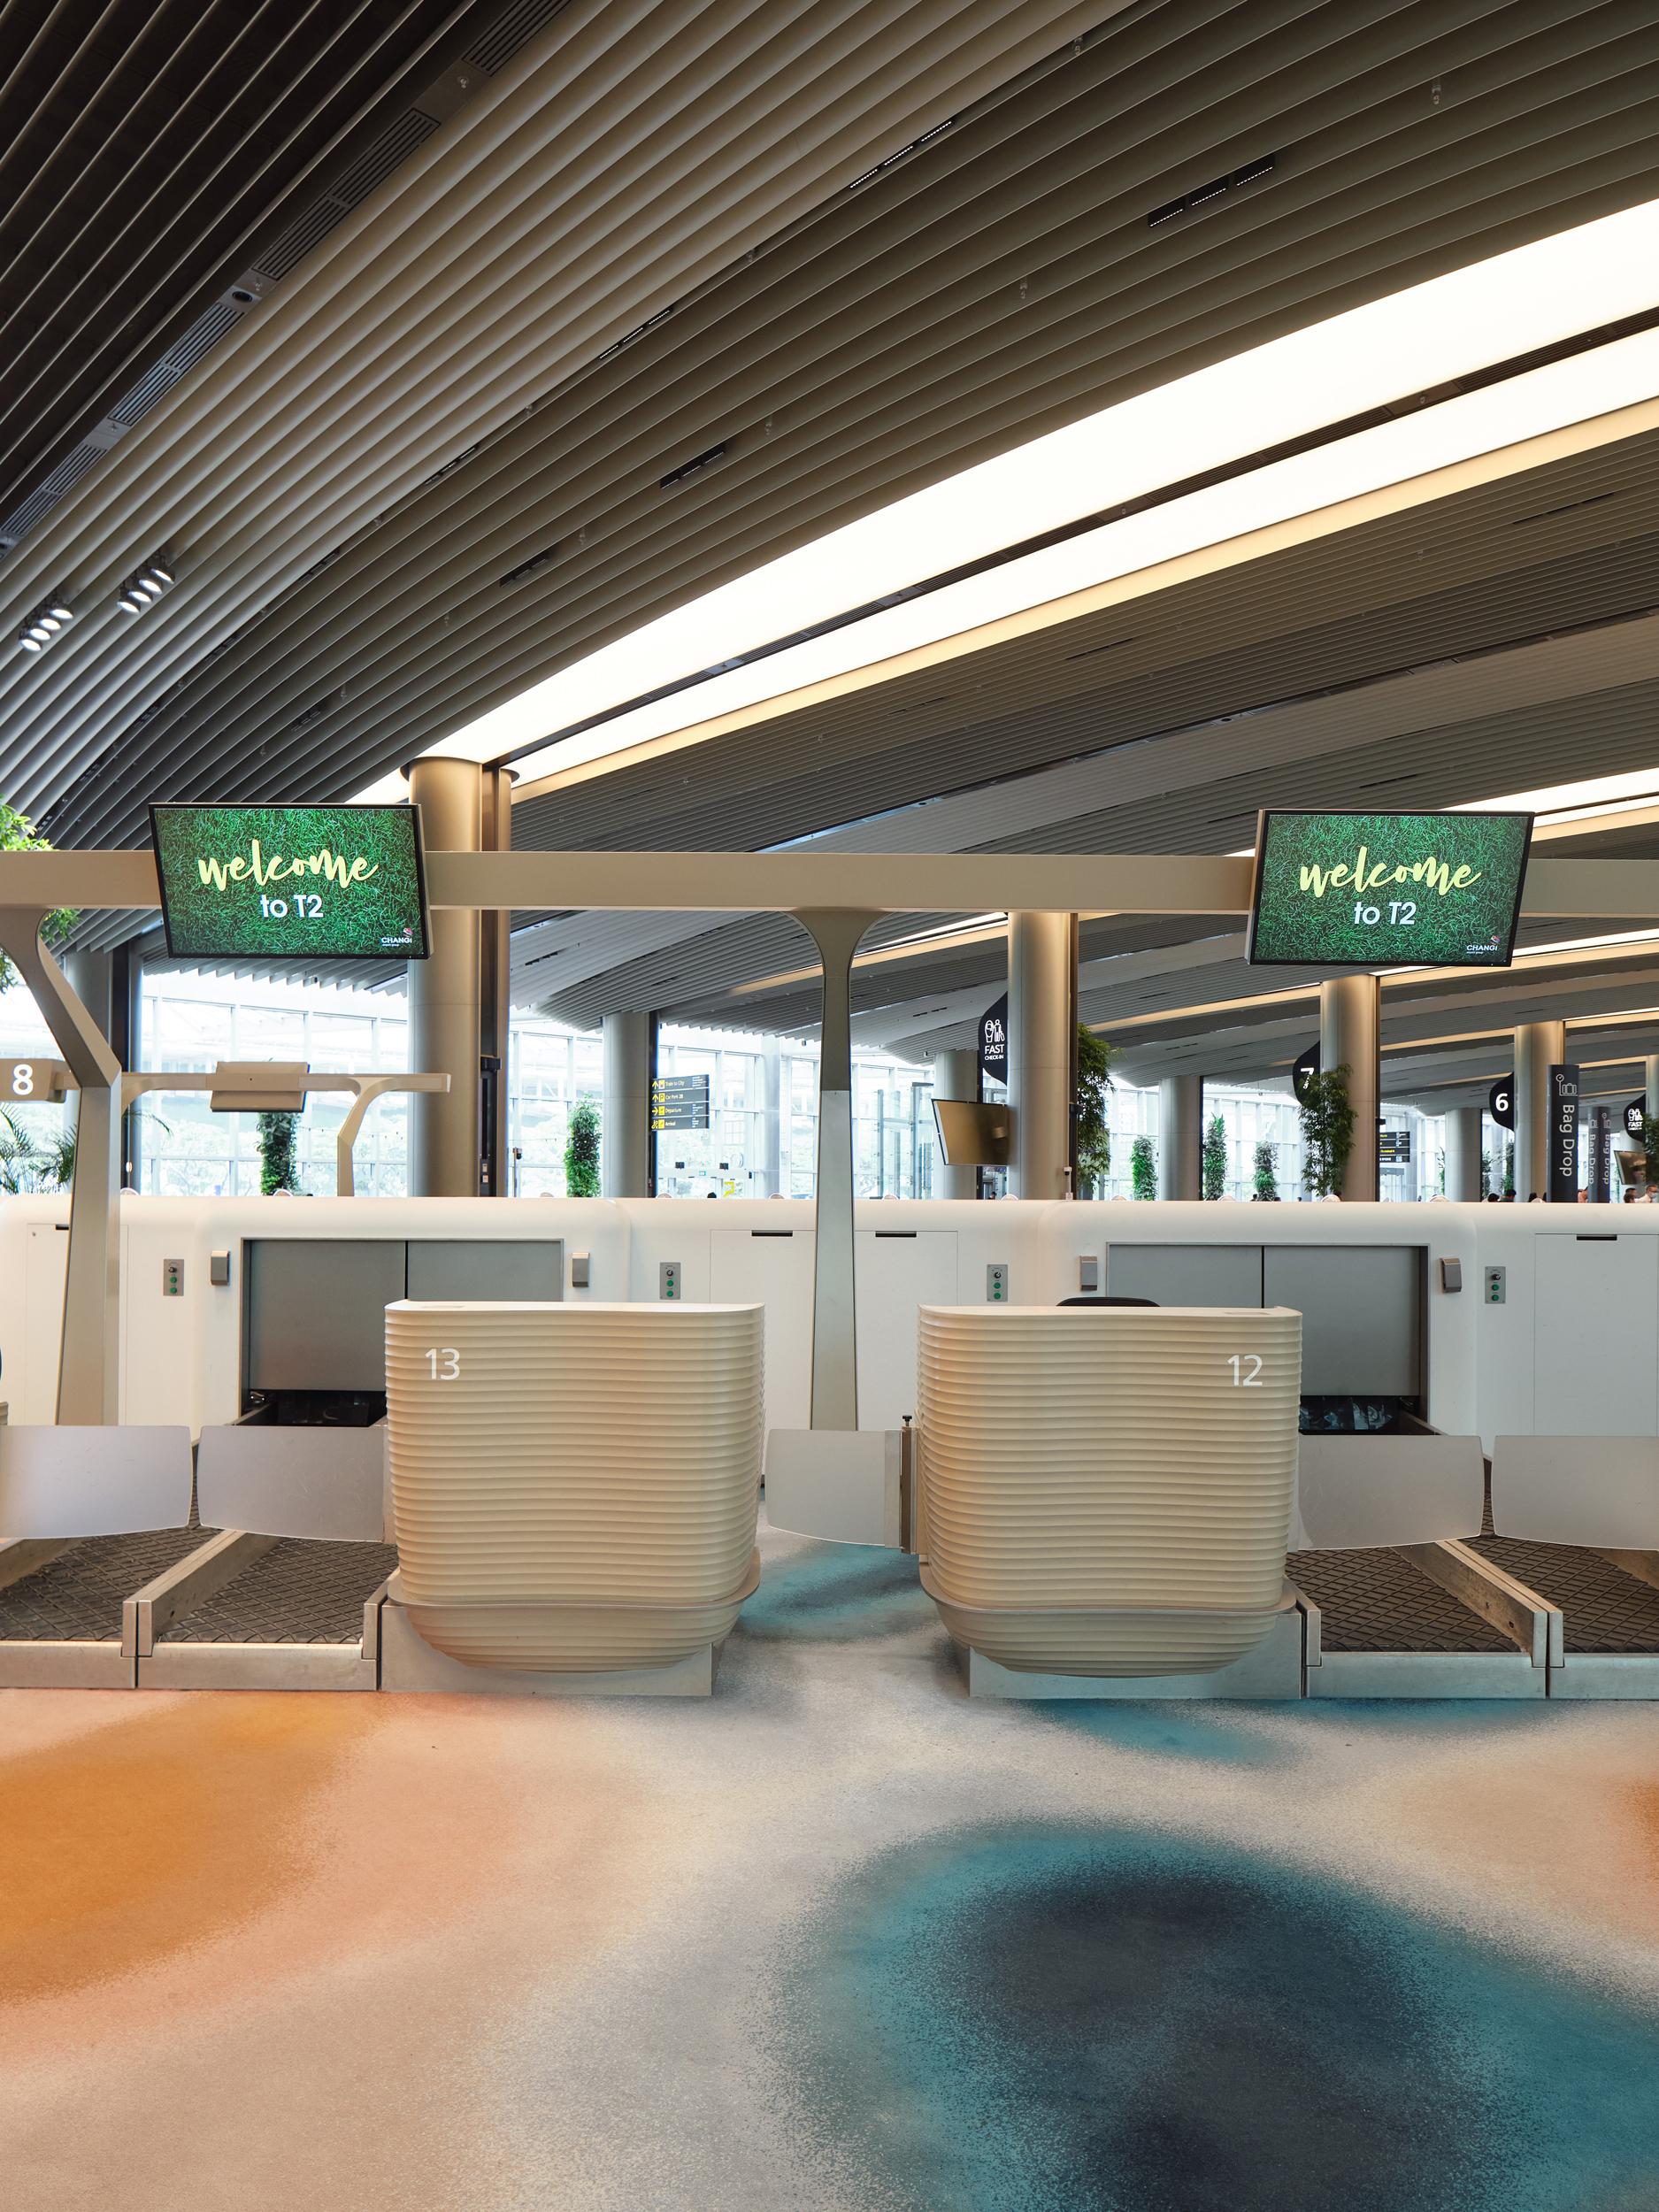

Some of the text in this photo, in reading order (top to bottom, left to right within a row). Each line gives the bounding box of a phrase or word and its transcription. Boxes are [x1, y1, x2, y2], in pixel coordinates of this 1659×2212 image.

[198, 839, 379, 891] welcome
[1300, 846, 1482, 898] welcome
[260, 894, 324, 918] to T2
[1354, 902, 1417, 925] to T2
[985, 1044, 1005, 1055] FAST
[12, 1064, 34, 1095] 8
[1300, 1067, 1315, 1090] 7
[1495, 1093, 1509, 1111] 6
[1559, 1104, 1575, 1177] Bag Drop
[425, 1348, 460, 1380] 13
[1226, 1354, 1263, 1386] 12
